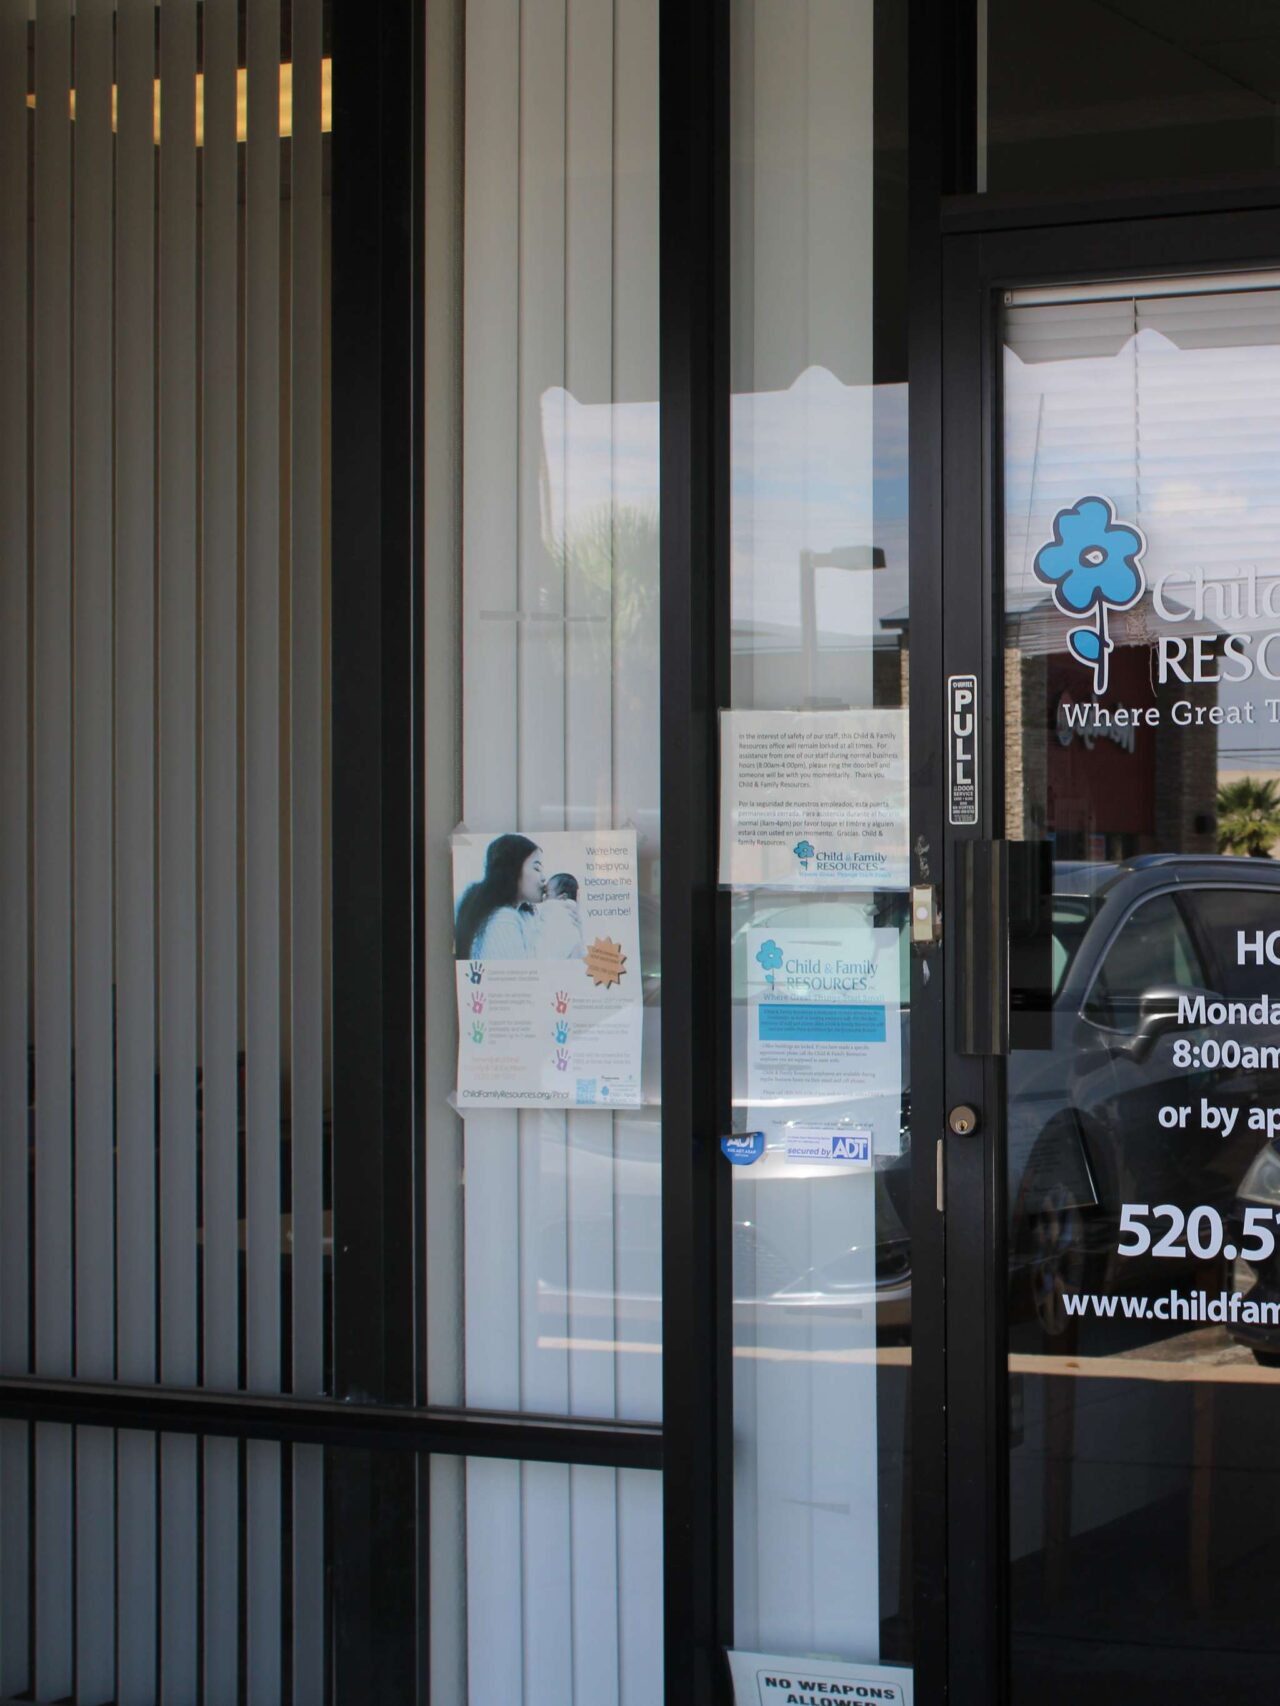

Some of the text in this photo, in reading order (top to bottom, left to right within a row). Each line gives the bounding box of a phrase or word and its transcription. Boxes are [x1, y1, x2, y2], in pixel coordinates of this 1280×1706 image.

[1063, 702, 1160, 728] Where
[1171, 701, 1253, 726] Great
[877, 732, 896, 740] Family
[953, 690, 972, 784] PULL
[816, 852, 843, 861] Child
[853, 852, 887, 863] Family
[817, 862, 879, 871] RESOURCES
[585, 878, 618, 886] become
[587, 892, 629, 901] best parent
[786, 959, 878, 978] Child & Family
[787, 977, 867, 991] RESOURCES
[1158, 1106, 1191, 1129] or
[1200, 1099, 1239, 1137] by
[833, 1138, 868, 1158] ADT
[765, 1677, 895, 1700] NO WEAPONS
